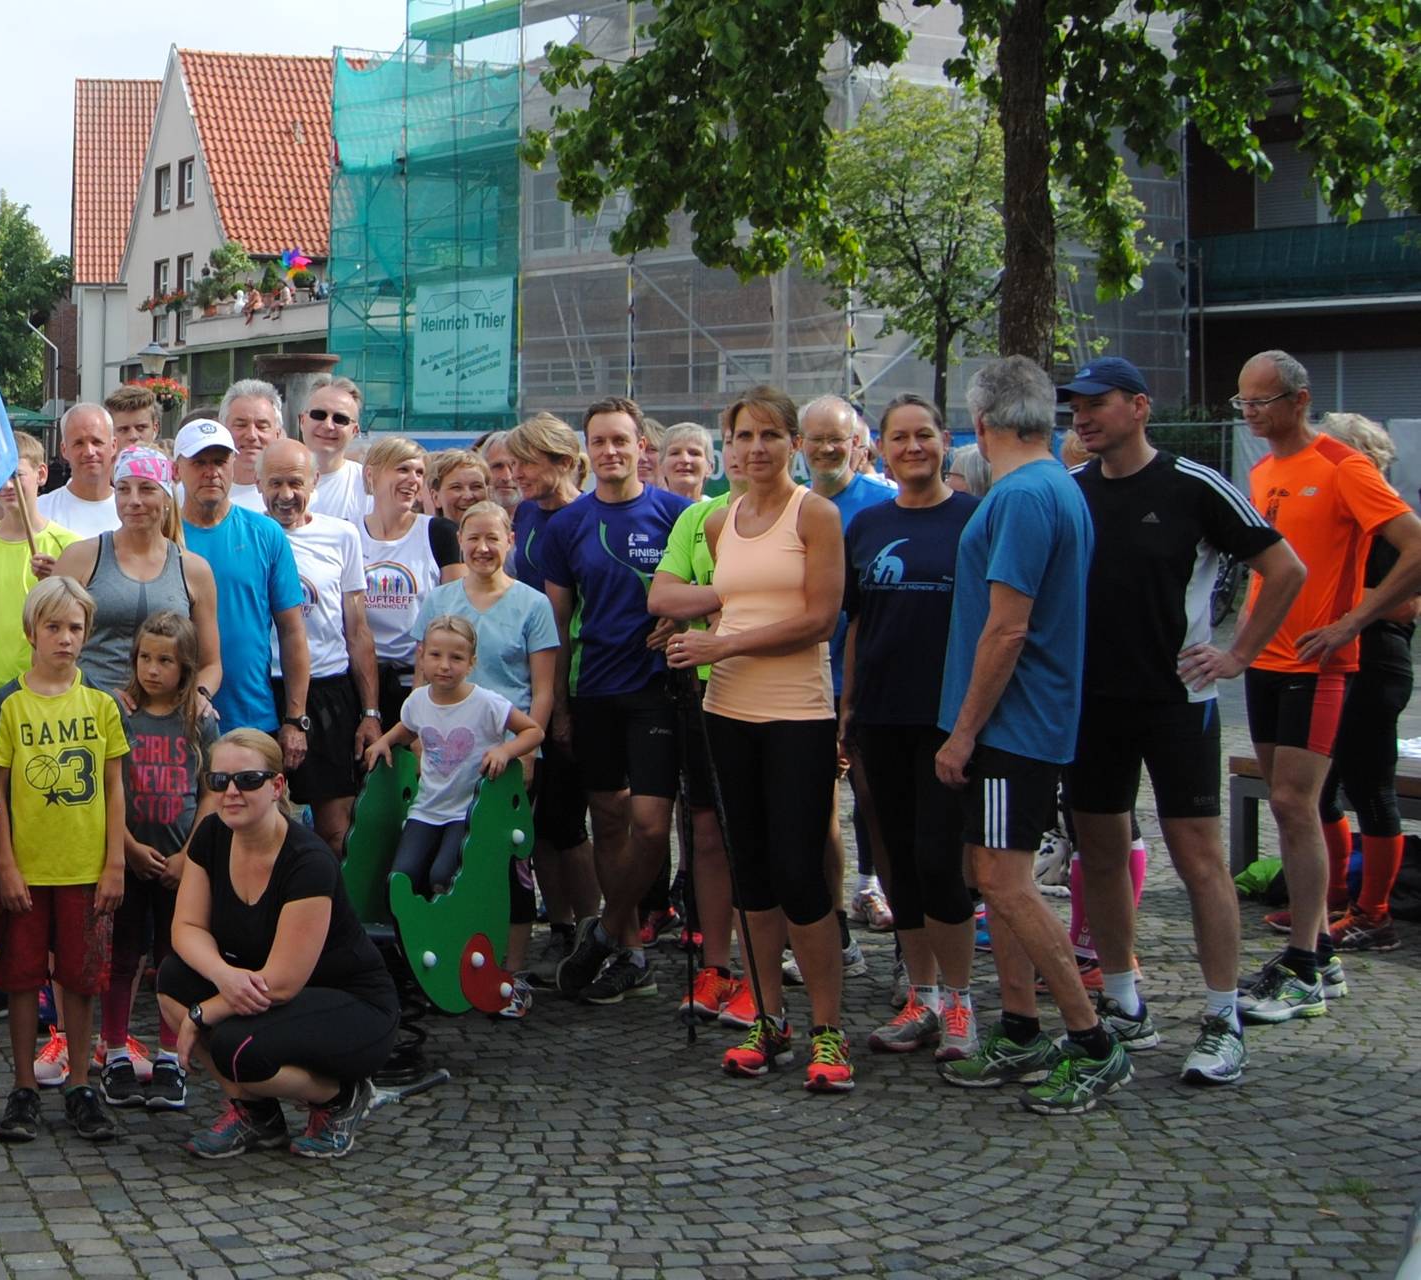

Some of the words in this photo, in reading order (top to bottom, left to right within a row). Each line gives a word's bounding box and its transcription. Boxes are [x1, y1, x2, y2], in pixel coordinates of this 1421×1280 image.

[421, 312, 469, 333] Heinrich
[473, 311, 507, 330] Thier
[628, 548, 664, 558] FINISH
[364, 595, 415, 604] AUFTREFF
[20, 716, 99, 747] GAME
[132, 733, 188, 765] GIRLS
[57, 745, 98, 807] 3
[129, 764, 190, 794] NEVER
[133, 794, 186, 825] STOP
